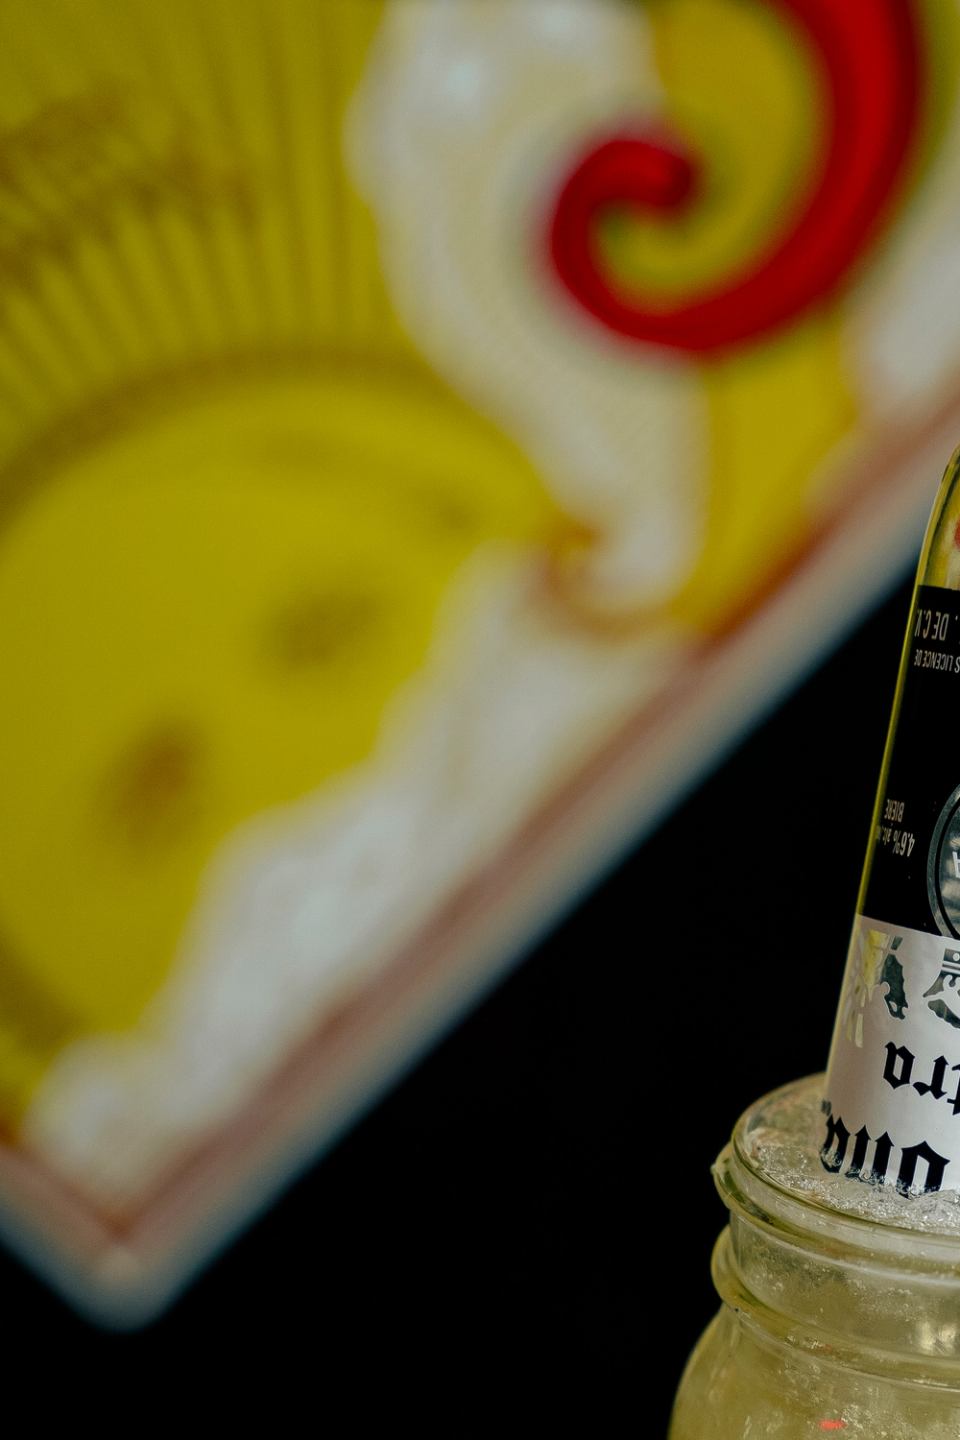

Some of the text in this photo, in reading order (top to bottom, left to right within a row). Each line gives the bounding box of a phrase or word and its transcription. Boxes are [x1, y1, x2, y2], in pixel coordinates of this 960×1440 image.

[931, 610, 950, 641] DE
[922, 650, 953, 672] LICENCE
[893, 830, 916, 857] 4.6%
